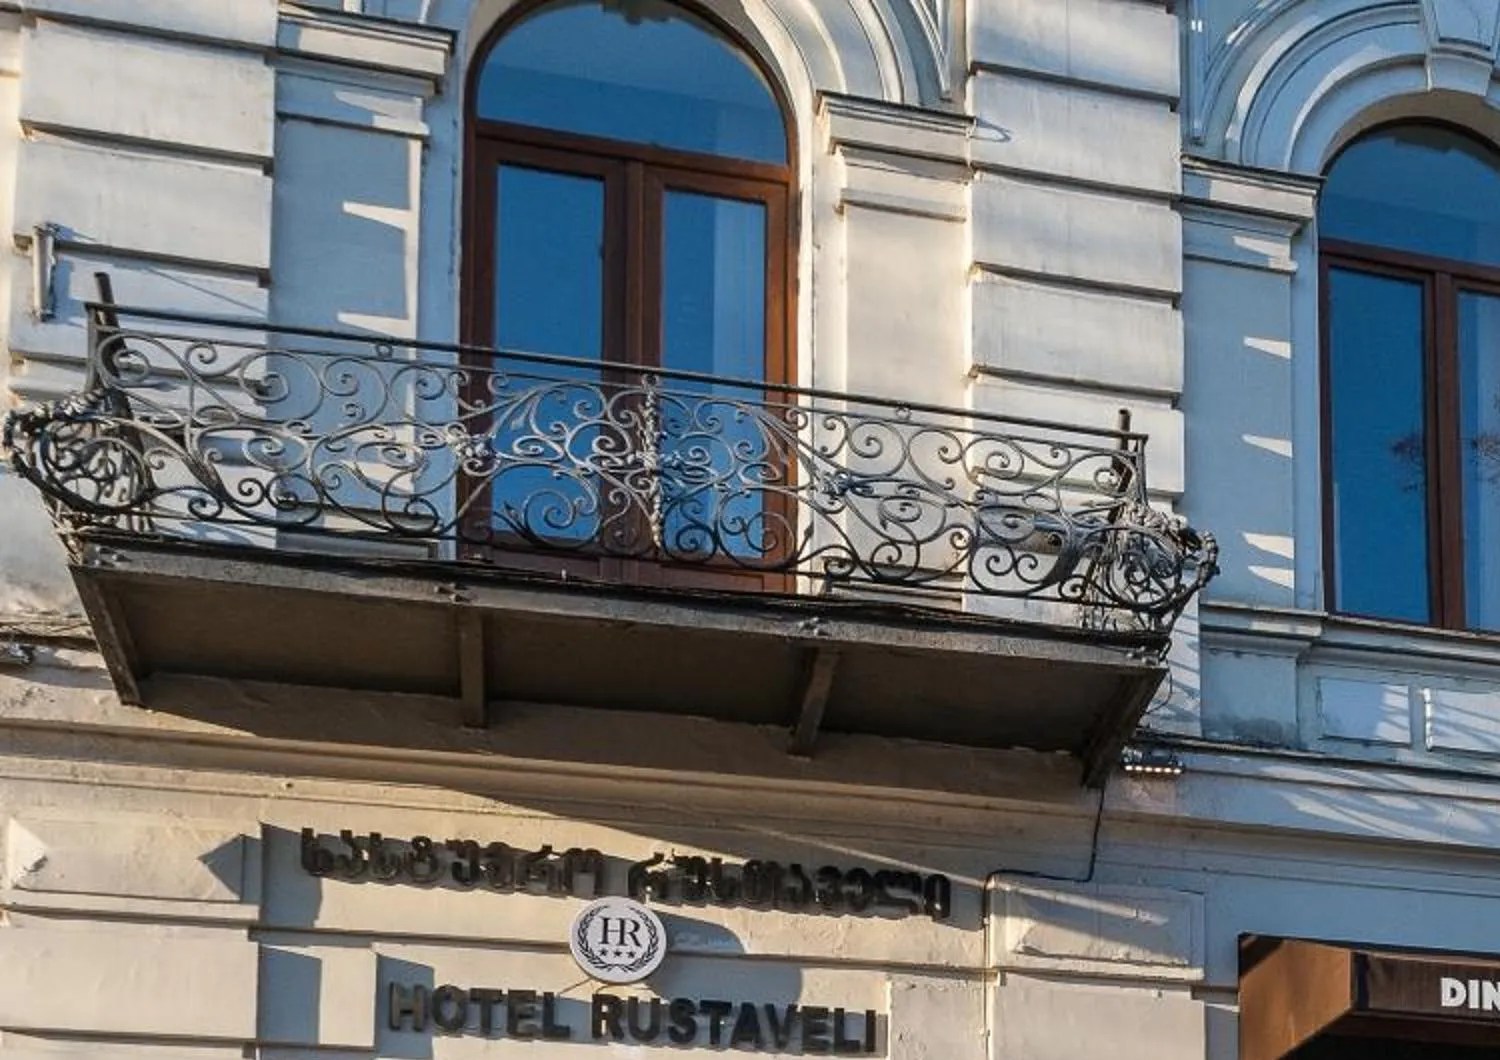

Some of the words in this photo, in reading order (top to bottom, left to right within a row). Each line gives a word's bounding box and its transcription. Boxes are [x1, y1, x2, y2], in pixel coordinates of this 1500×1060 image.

[598, 915, 642, 948] HR
[389, 981, 571, 1038] HOTEL
[591, 993, 877, 1053] RUSTAVELI
